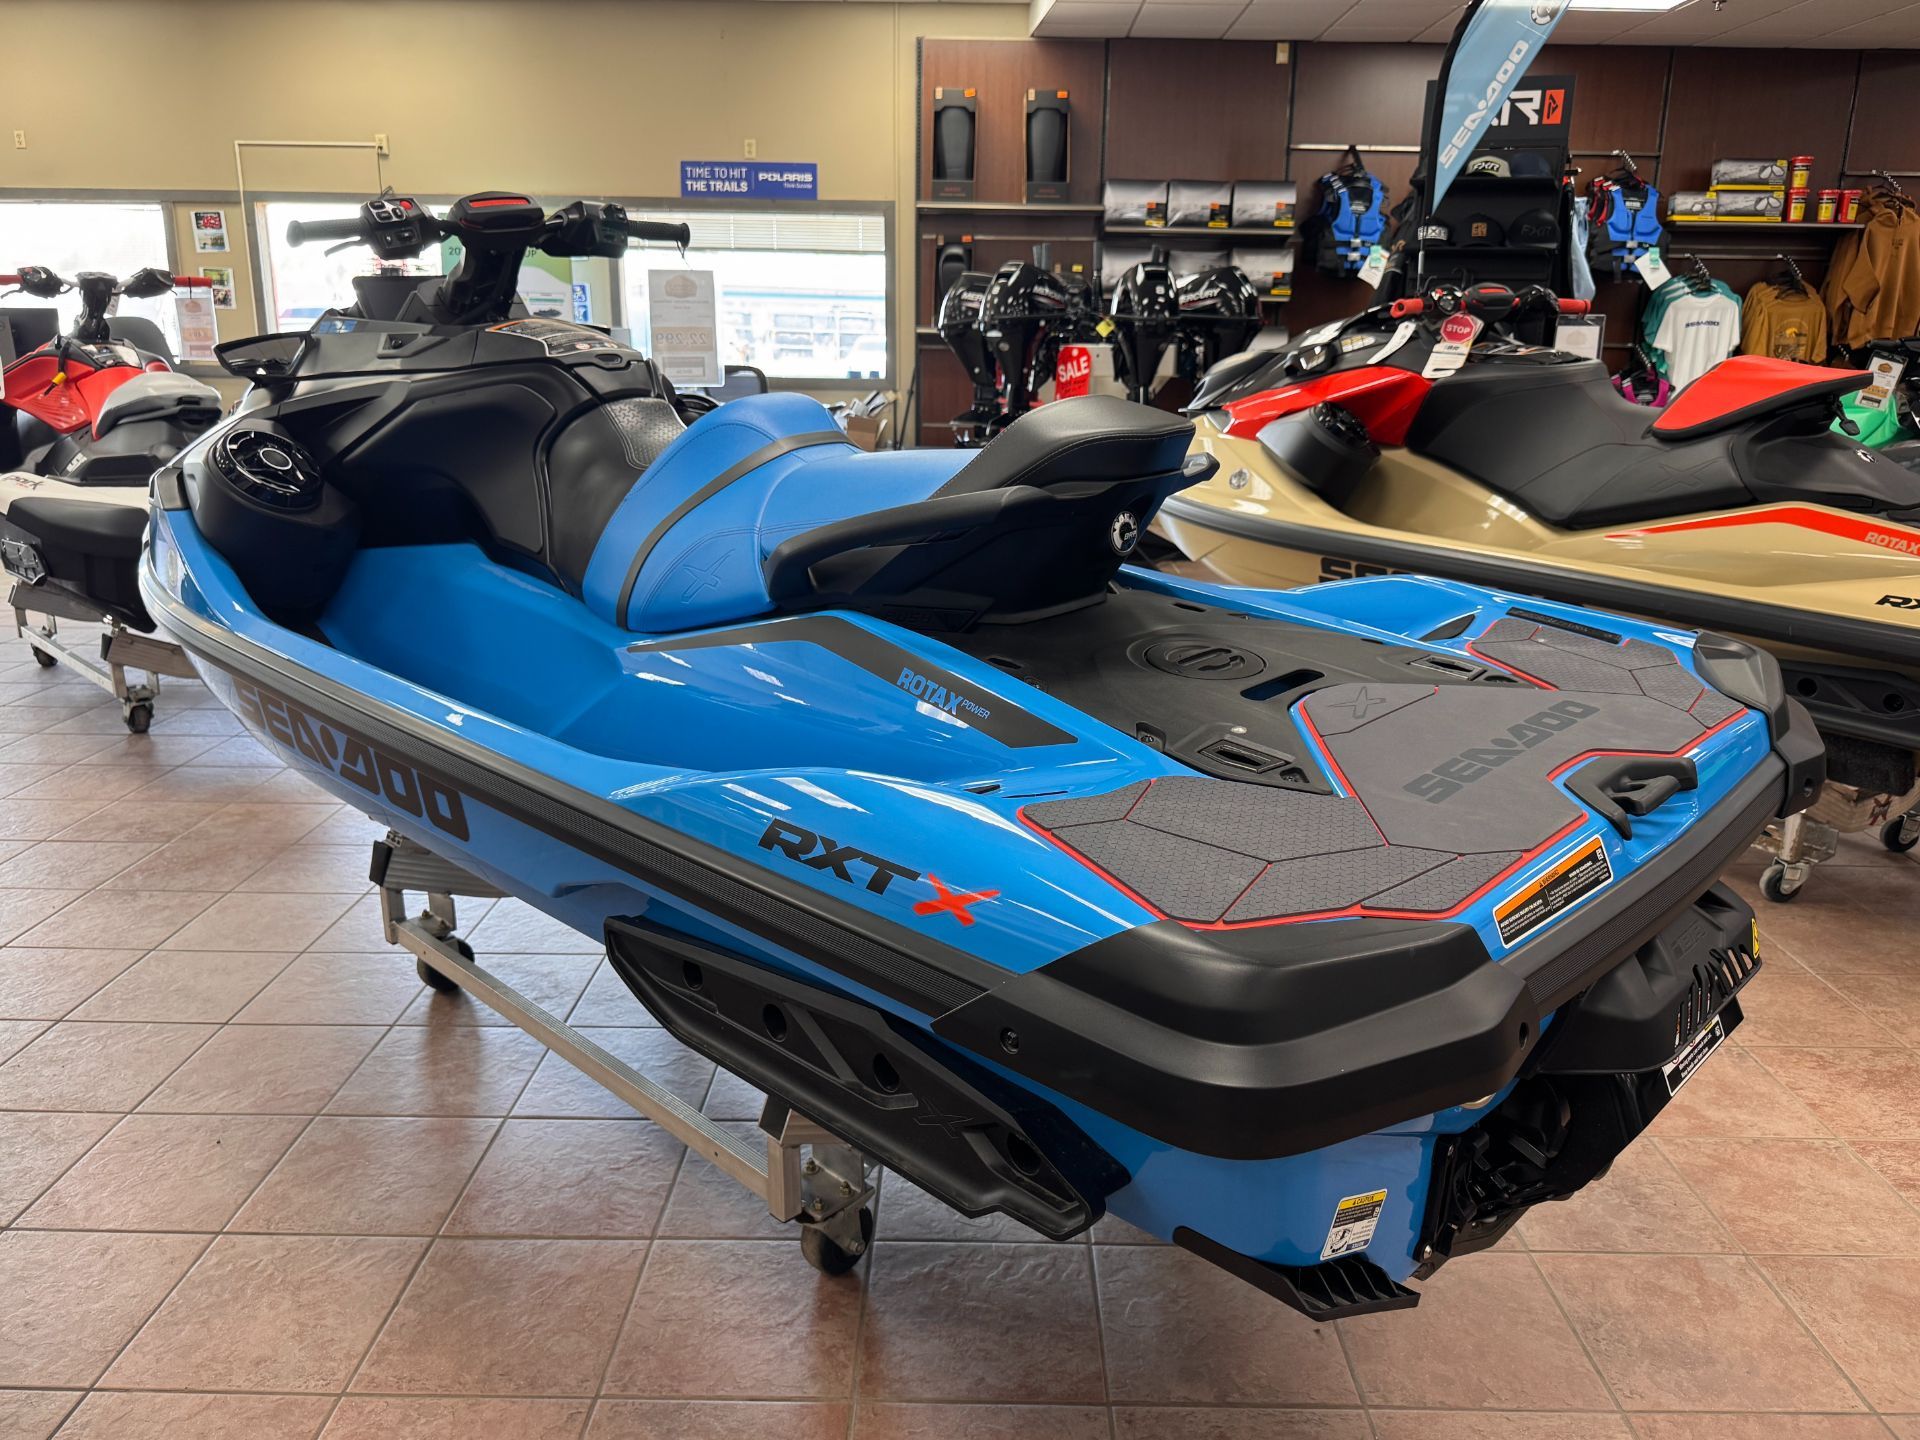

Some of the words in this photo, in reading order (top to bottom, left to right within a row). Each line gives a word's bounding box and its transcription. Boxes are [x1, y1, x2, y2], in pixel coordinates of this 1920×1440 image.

[686, 167, 711, 179] TIME
[714, 167, 727, 179] TO
[729, 168, 747, 179] HIT
[758, 172, 813, 182] POLARIS
[686, 181, 707, 192] THE
[709, 181, 748, 192] TRAILS
[449, 247, 461, 257] 20
[1446, 323, 1471, 334] STOP
[1057, 356, 1090, 383] SALE
[1864, 531, 1920, 554] ROTAX
[896, 667, 964, 716] ROTAX
[961, 699, 991, 719] POWER
[758, 818, 921, 896] RXT
